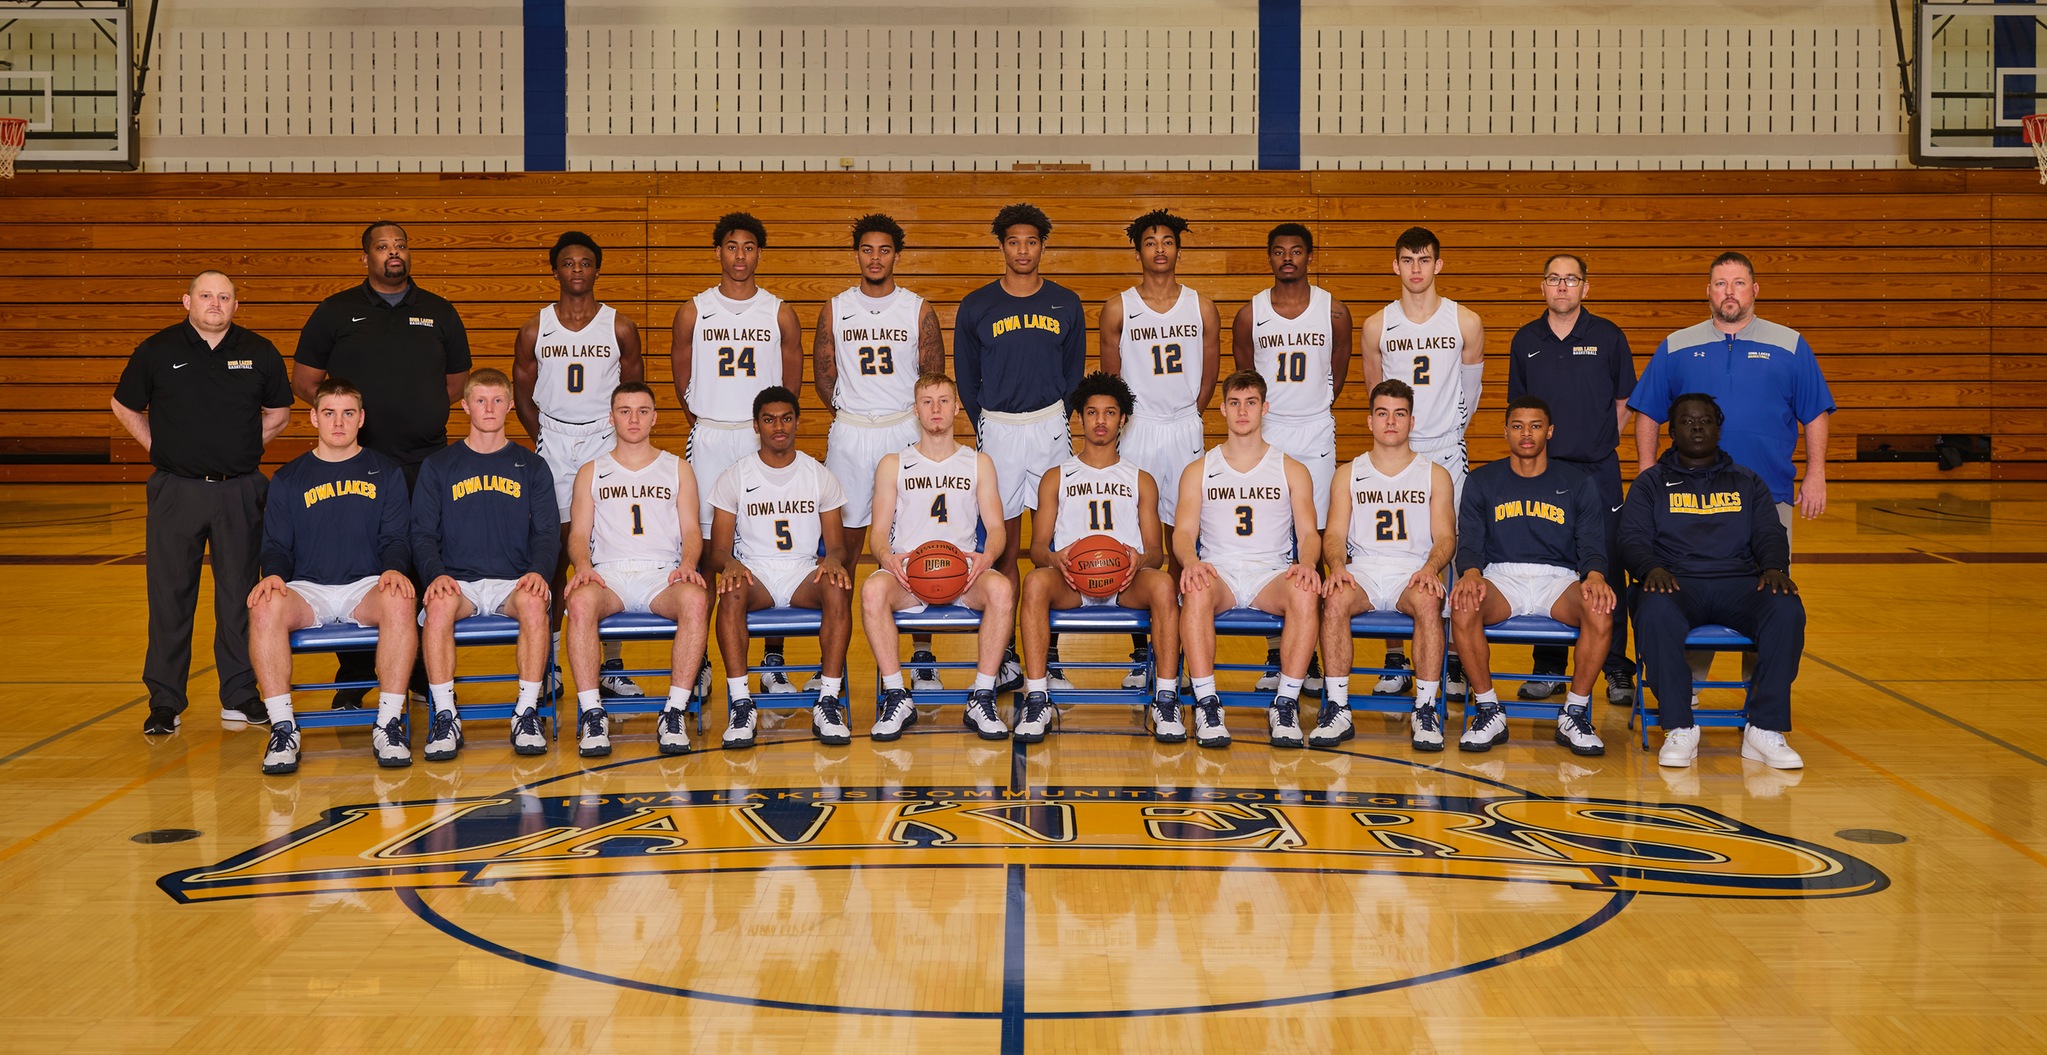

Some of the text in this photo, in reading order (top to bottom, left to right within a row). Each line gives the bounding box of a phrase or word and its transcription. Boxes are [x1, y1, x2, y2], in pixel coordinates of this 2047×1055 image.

[843, 328, 908, 341] IOWA LAKES
[992, 314, 1060, 338] IOWA LAKES
[1130, 325, 1198, 341] IOWA LAKES
[703, 328, 771, 342] IOWA LAKES
[1258, 333, 1325, 349] IOWA LAKES
[542, 345, 610, 358] IOWA LAKES
[1386, 336, 1456, 352] IOWA LAKES
[718, 347, 756, 377] 24
[858, 346, 894, 376] 23
[1151, 343, 1183, 376] 12
[1276, 352, 1306, 382] 10
[567, 363, 584, 394] 0
[1413, 355, 1430, 385] 2
[452, 474, 521, 502] IOWA LAKES
[905, 475, 971, 491] IOWA LAKES
[1066, 482, 1132, 498] IOWA LAKES
[304, 480, 377, 509] IOWA LAKES
[600, 485, 671, 500] IOWA LAKES
[1207, 487, 1281, 500] IOWA LAKES
[1356, 490, 1425, 504] IOWA LAKES
[1670, 492, 1741, 509] IOWA LAKES
[747, 500, 814, 516] IOWA LAKES
[930, 493, 948, 524] 4
[1088, 500, 1114, 530] 11
[1495, 500, 1565, 525] IOWA LAKES
[631, 503, 644, 536] 1
[1234, 505, 1254, 536] 3
[1376, 508, 1408, 541] 21
[774, 519, 794, 551] 5
[915, 544, 959, 556] SPALDING
[924, 559, 951, 572] NJCAA
[1078, 557, 1121, 571] SPALDING
[1088, 577, 1114, 589] NJCAA
[562, 795, 690, 807] IOWA
[712, 791, 868, 801] LAKES
[1202, 791, 1430, 806] COLLEGE
[158, 796, 1888, 900] LAKERS
